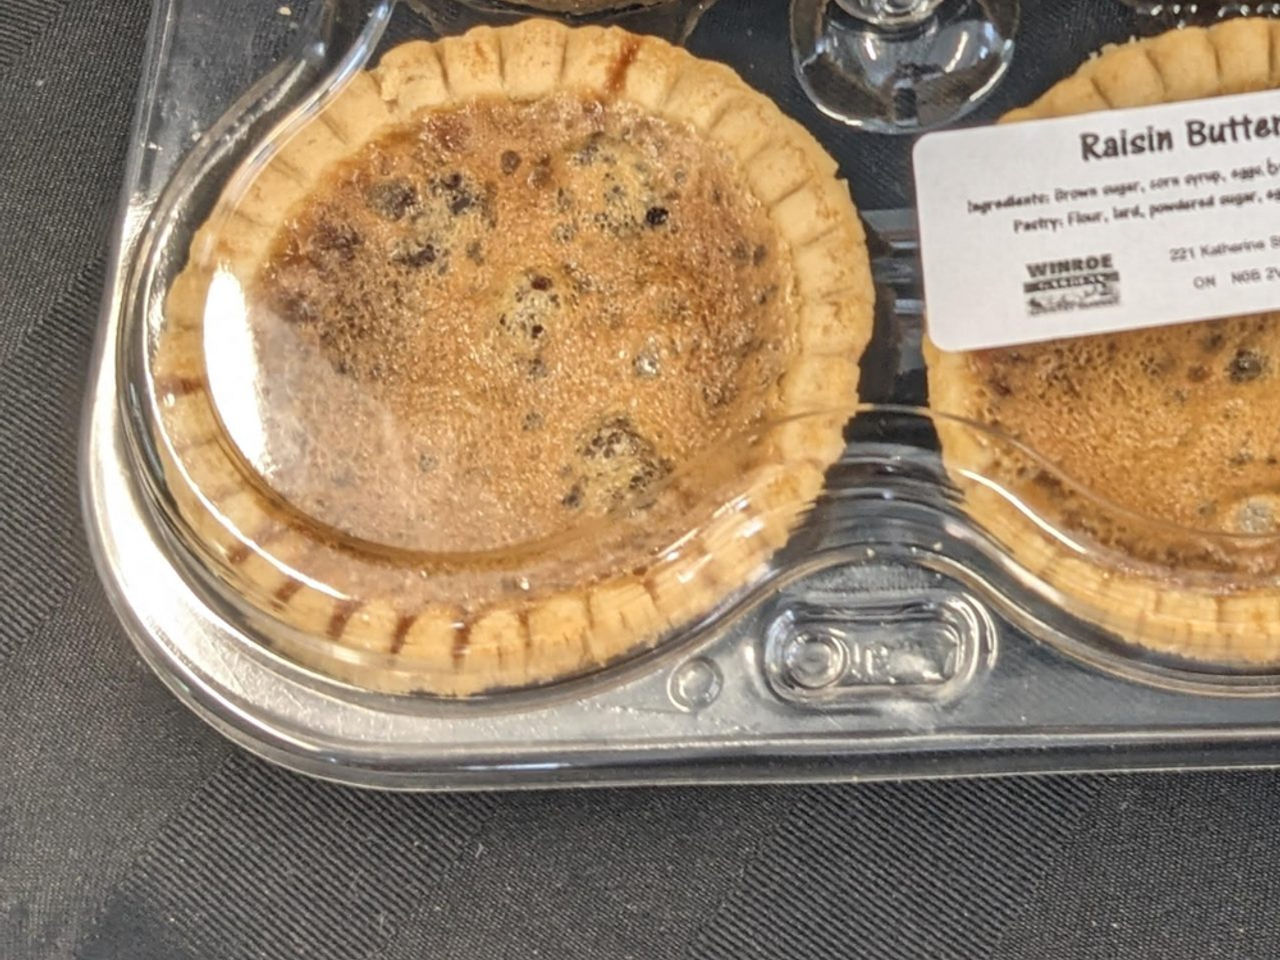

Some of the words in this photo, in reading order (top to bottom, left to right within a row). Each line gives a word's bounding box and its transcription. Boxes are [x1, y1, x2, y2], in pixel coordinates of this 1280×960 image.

[1080, 126, 1174, 162] Raisin
[967, 193, 1050, 214] Ingredients:
[1054, 187, 1098, 202] Brown
[1102, 181, 1145, 196] sugar,
[1150, 175, 1180, 189] corn
[1184, 170, 1226, 187] syrup,
[1067, 211, 1108, 226] Flour,
[1113, 205, 1145, 220] lard,
[1149, 196, 1215, 217] powdered
[1219, 191, 1263, 206] sugar,
[1025, 253, 1113, 278] WINROE
[1169, 247, 1195, 262] 221
[1193, 276, 1216, 289] ON
